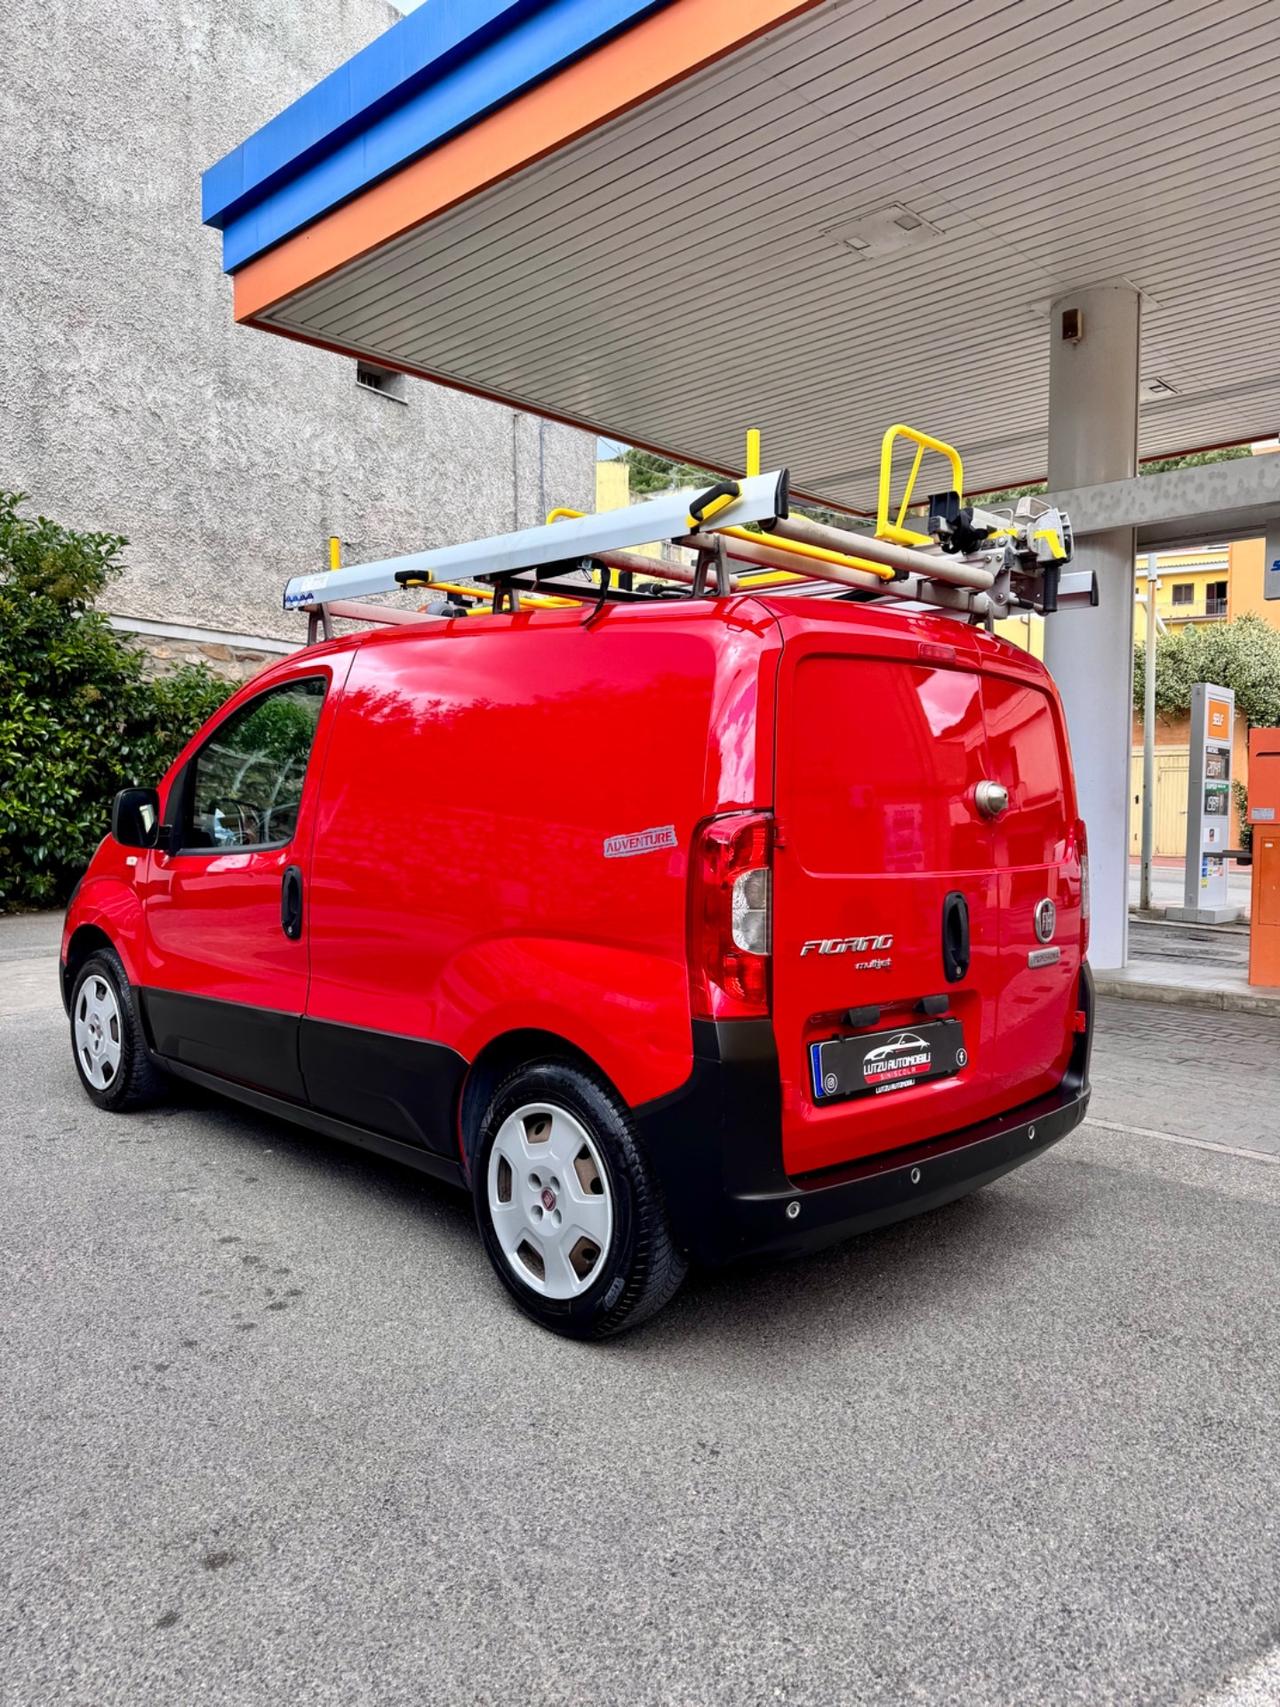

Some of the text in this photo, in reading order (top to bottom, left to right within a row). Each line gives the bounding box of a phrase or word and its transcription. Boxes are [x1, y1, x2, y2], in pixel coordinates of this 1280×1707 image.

[606, 831, 672, 852] ADVENTURE
[863, 1052, 931, 1075] LUTZU AUTOMOBILI
